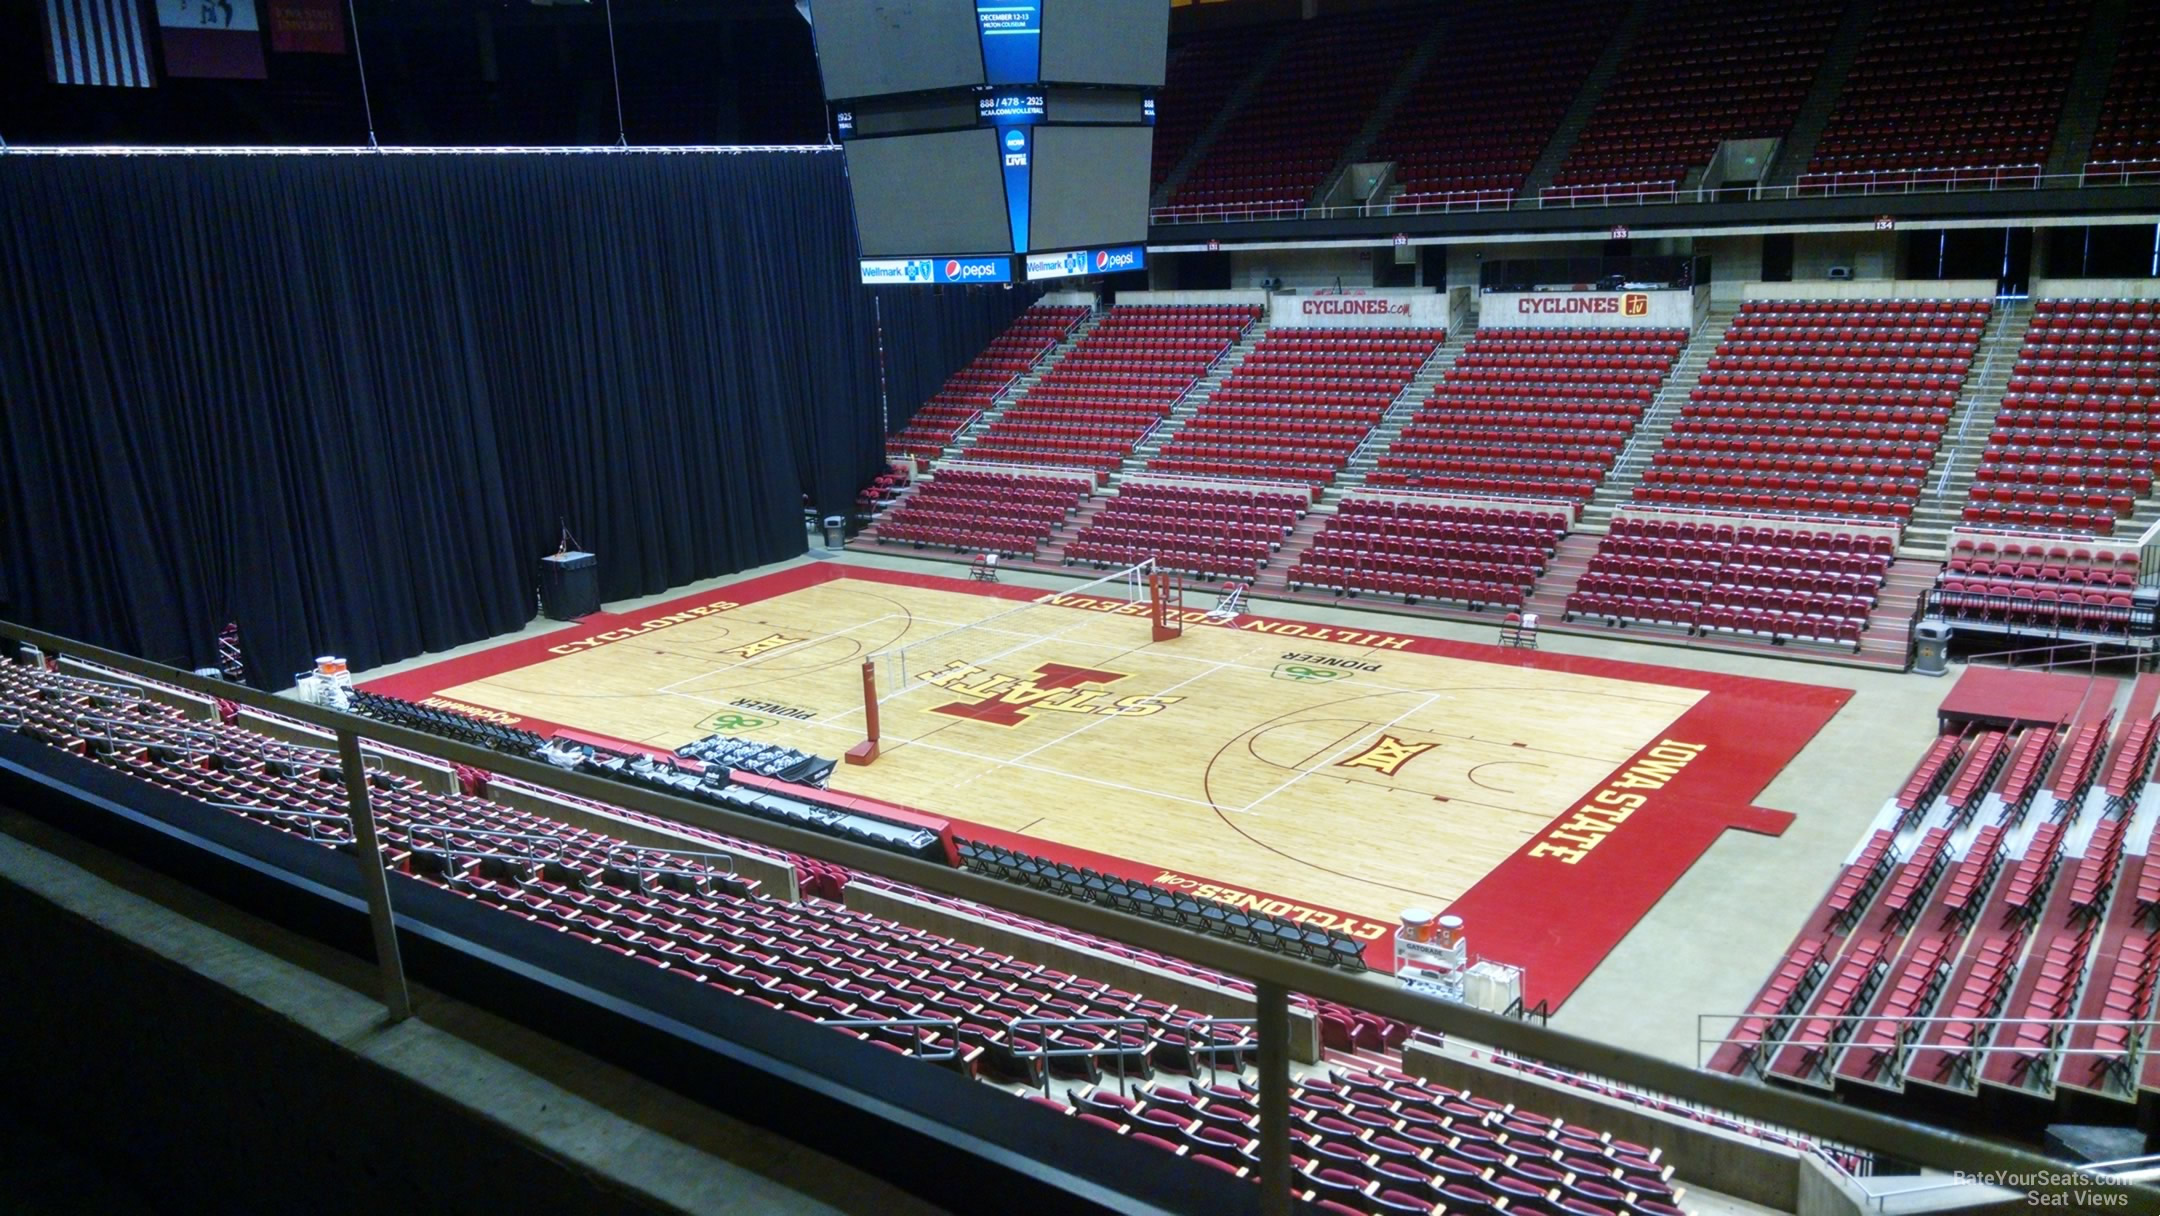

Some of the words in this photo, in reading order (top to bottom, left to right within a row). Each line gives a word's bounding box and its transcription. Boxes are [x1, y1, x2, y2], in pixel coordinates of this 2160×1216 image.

[980, 13, 1012, 21] DECEMBER
[980, 98, 995, 108] 888
[1001, 97, 1019, 106] 478
[1026, 97, 1044, 106] 2925
[1006, 157, 1027, 166] LIVE
[1876, 221, 1892, 230] 134
[1613, 230, 1627, 238] 133
[1027, 260, 1063, 272] Wellmark
[1109, 252, 1134, 268] pepsi
[862, 266, 902, 277] Wellmark
[962, 262, 996, 279] pepsi
[1518, 297, 1619, 314] CYCLONES
[547, 600, 740, 654] CYCLONES
[1240, 619, 1415, 650] HILTON
[1281, 652, 1383, 672] PIONEER
[915, 659, 1188, 717] STATE
[729, 698, 818, 720] PIONEER
[1611, 738, 1707, 790] IOWA
[1527, 789, 1648, 865] STATE
[1406, 943, 1443, 956] GATORADE
